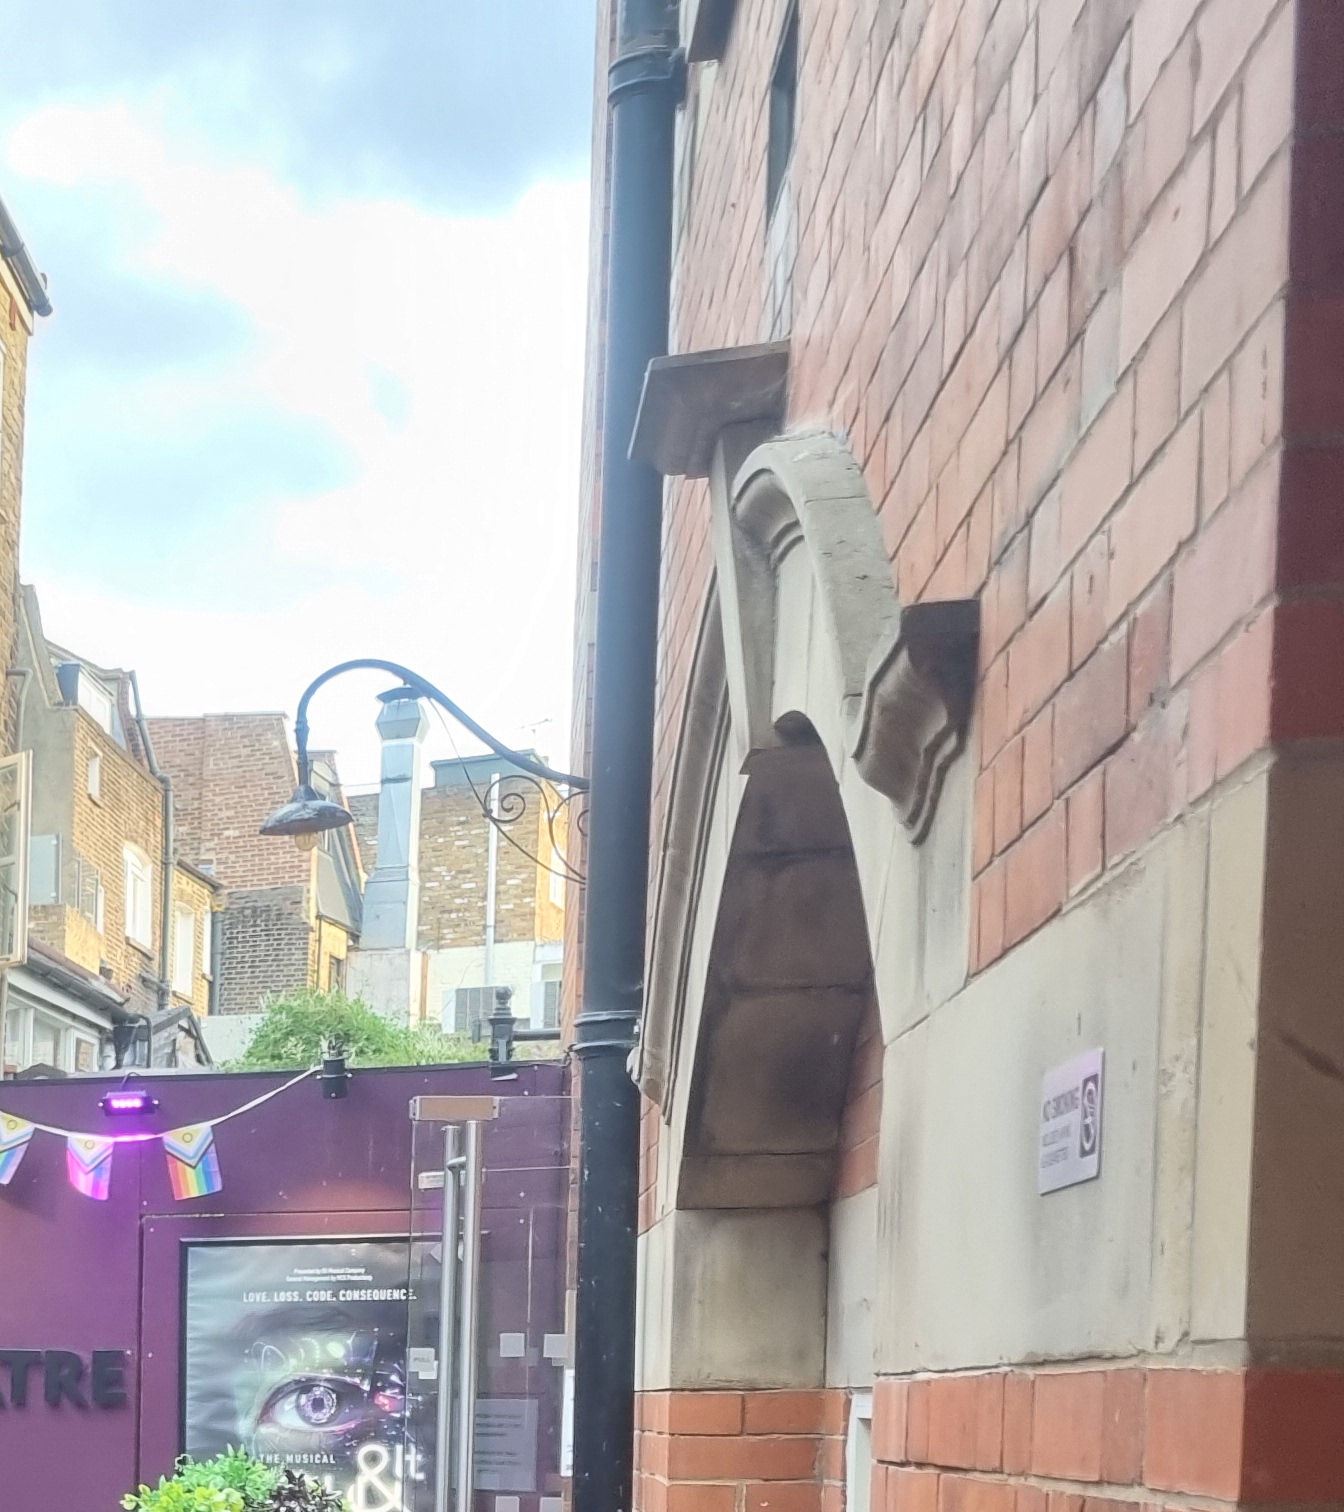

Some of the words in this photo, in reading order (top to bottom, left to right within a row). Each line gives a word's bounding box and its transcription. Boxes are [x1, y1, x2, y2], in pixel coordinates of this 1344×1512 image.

[243, 1292, 271, 1303] LOVE.
[274, 1291, 303, 1302] LOSS.
[306, 1290, 337, 1302] CODE.
[259, 1454, 280, 1464] THE
[286, 1452, 336, 1464] MUSICAL
